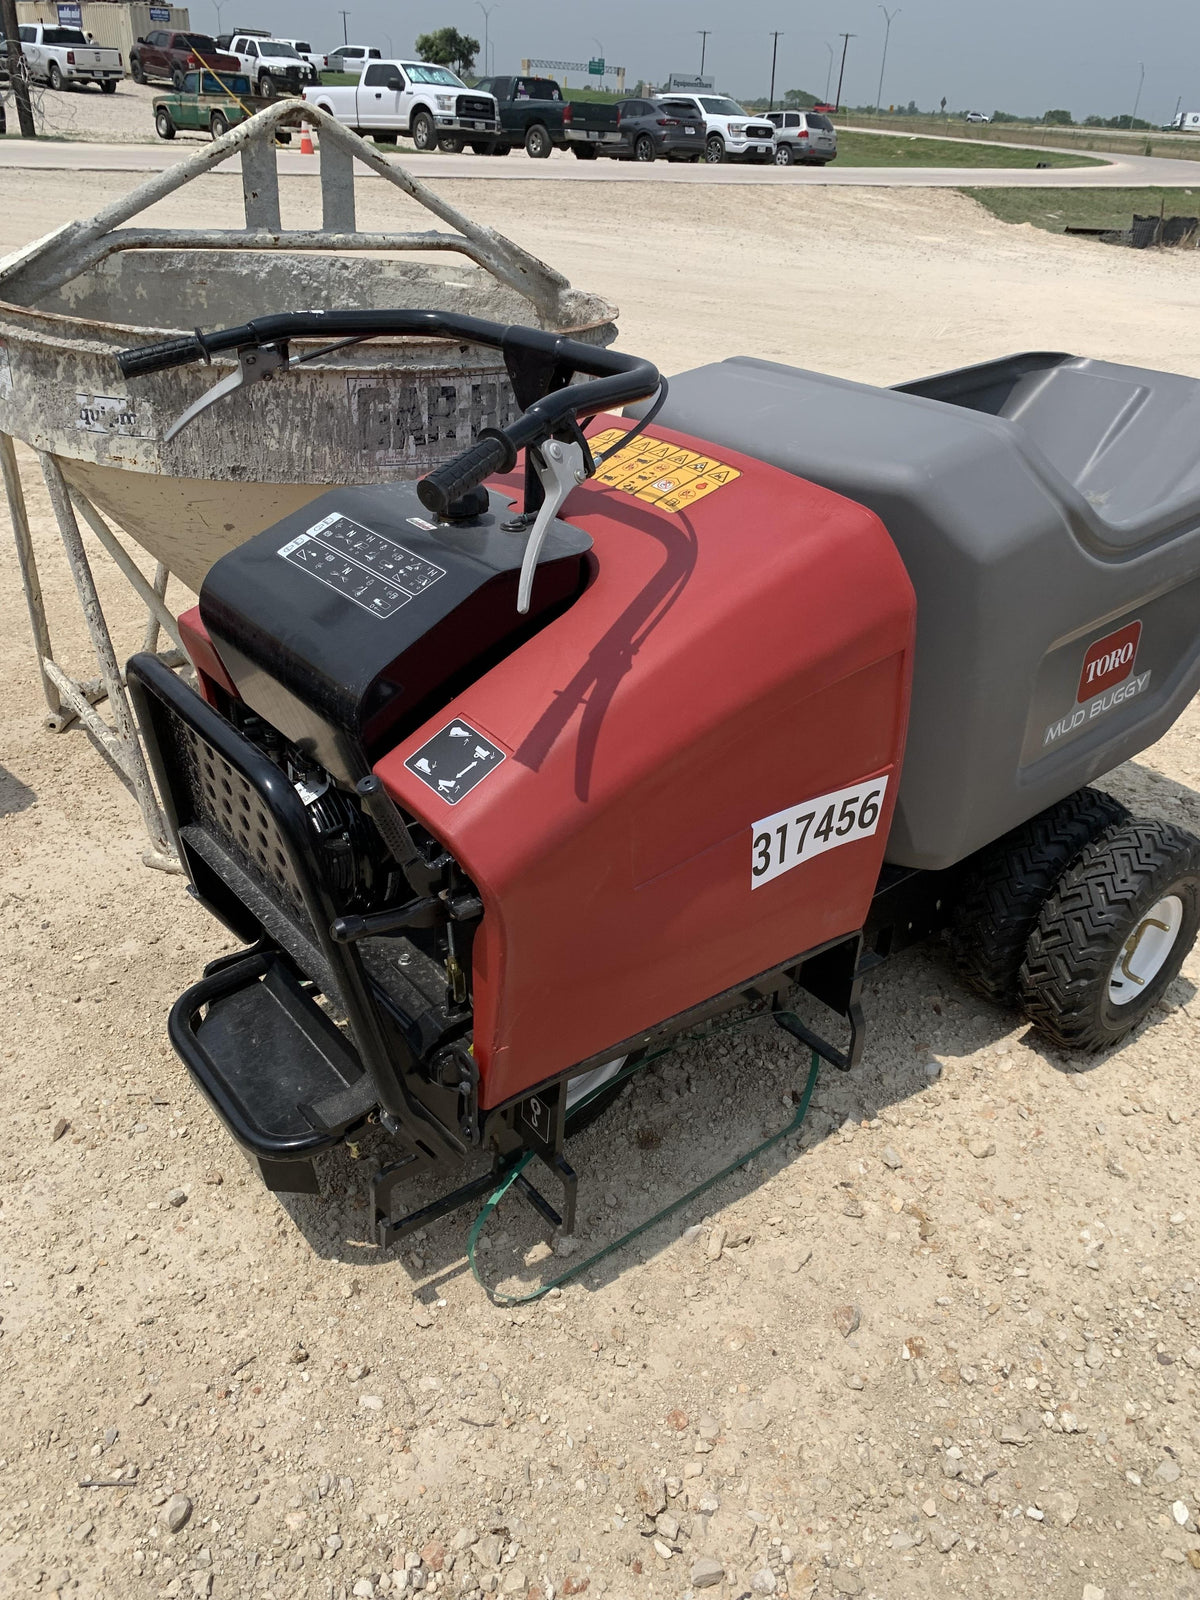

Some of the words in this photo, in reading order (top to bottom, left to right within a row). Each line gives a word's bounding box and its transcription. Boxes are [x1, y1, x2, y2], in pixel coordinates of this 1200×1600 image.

[1086, 642, 1134, 684] TORO
[1044, 710, 1086, 744] MUD
[1089, 673, 1148, 719] BUGGY
[752, 790, 881, 877] 317456
